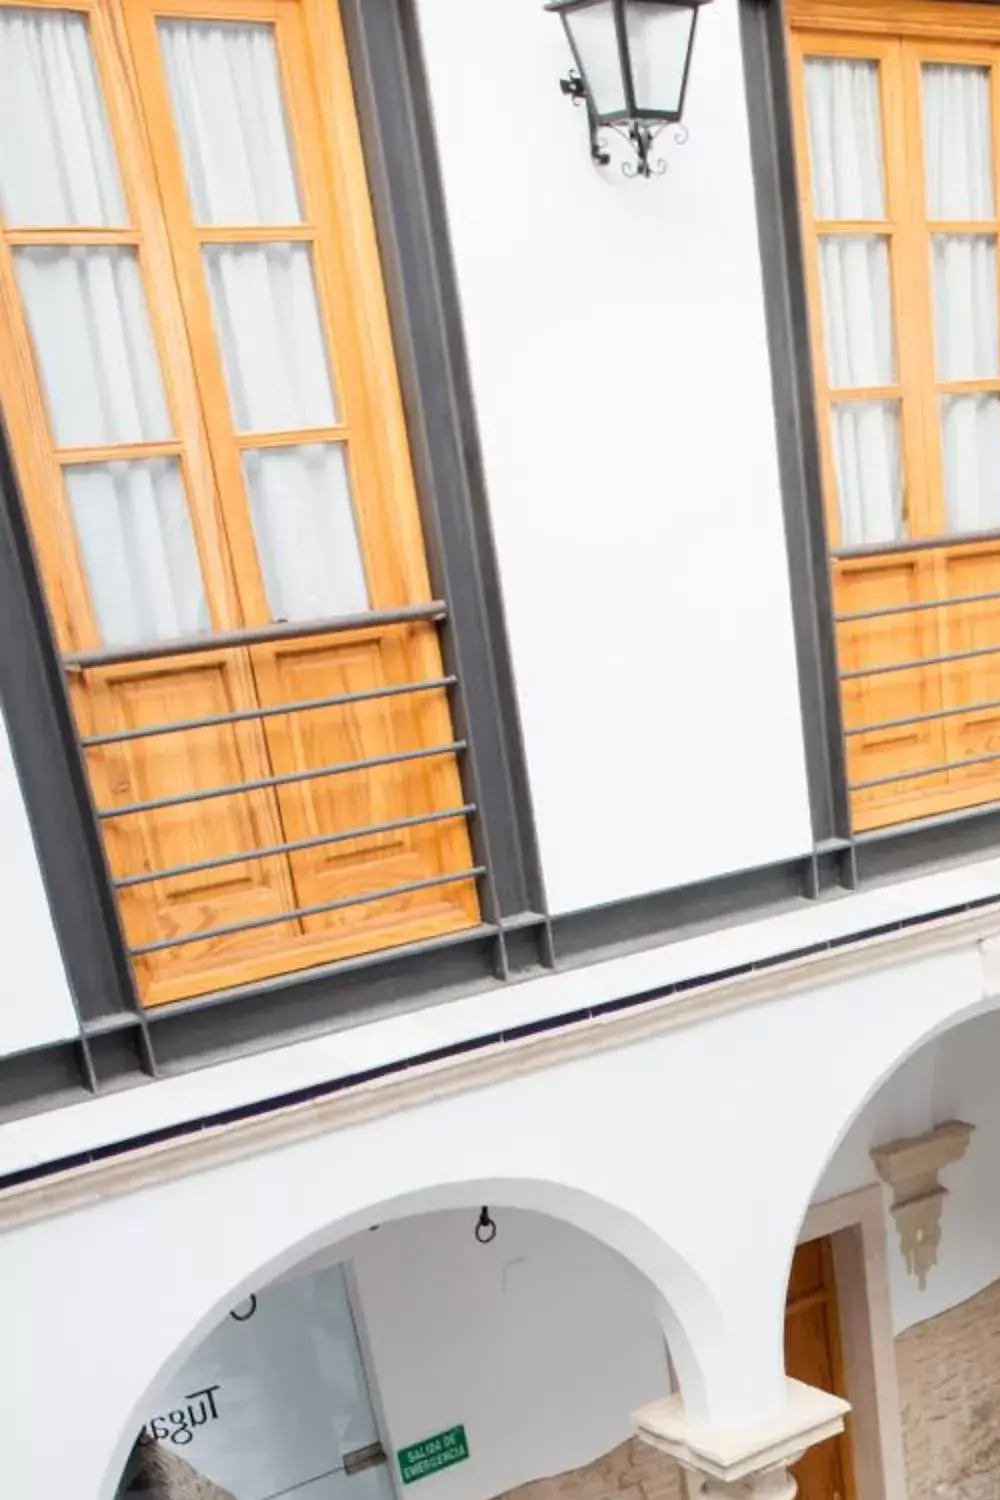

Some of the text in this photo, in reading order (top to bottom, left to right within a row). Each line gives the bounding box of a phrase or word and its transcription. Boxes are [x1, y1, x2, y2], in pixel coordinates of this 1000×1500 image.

[404, 1443, 464, 1480] EMERGENCIA
[407, 1433, 456, 1463] SALIDA DE
